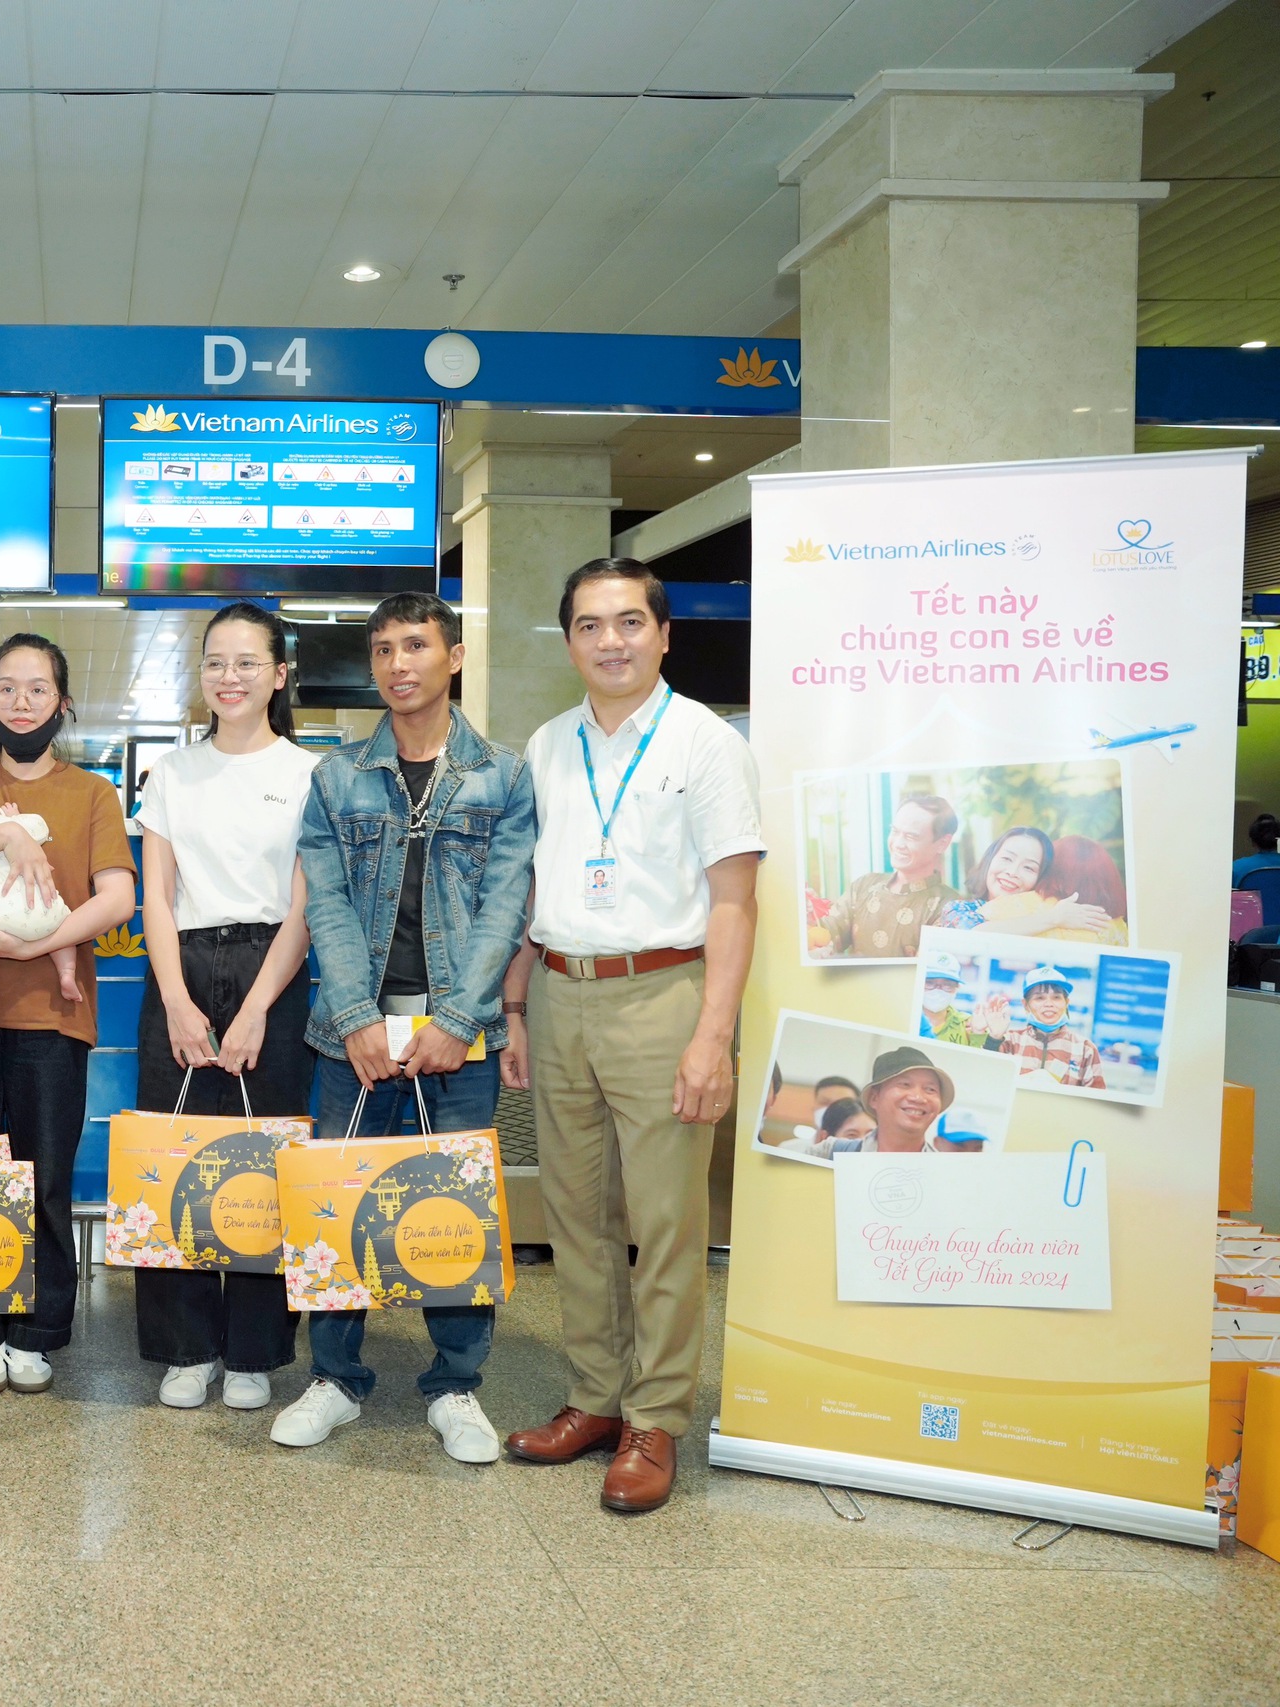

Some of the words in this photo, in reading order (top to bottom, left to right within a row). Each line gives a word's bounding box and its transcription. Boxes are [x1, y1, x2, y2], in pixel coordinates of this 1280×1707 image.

[203, 334, 312, 387] D-4
[181, 410, 284, 433] Vietnam
[287, 412, 379, 435] Airlines
[827, 542, 918, 561] Vietnam
[921, 538, 1006, 557] Airlines
[909, 582, 965, 616] Tết
[978, 587, 1038, 621] này
[841, 625, 939, 658] chúng
[949, 629, 1009, 650] con
[1022, 622, 1060, 648] sẽ
[1073, 614, 1116, 647] về
[791, 657, 867, 692] cùng
[877, 658, 1020, 685] Vietnam
[1031, 655, 1169, 683] Airlines
[264, 794, 287, 804] GULU
[946, 1227, 981, 1262] bay
[987, 1228, 1034, 1256] đoàn
[1042, 1239, 1080, 1256] viên
[1019, 1271, 1069, 1290] 2024
[734, 1393, 751, 1402] 1900
[752, 1396, 768, 1404] 1100
[930, 1394, 945, 1402] app
[821, 1405, 892, 1422] fb/vietnamairlines
[982, 1428, 1067, 1448] vietnamairlines.com
[1117, 1448, 1136, 1458] viên
